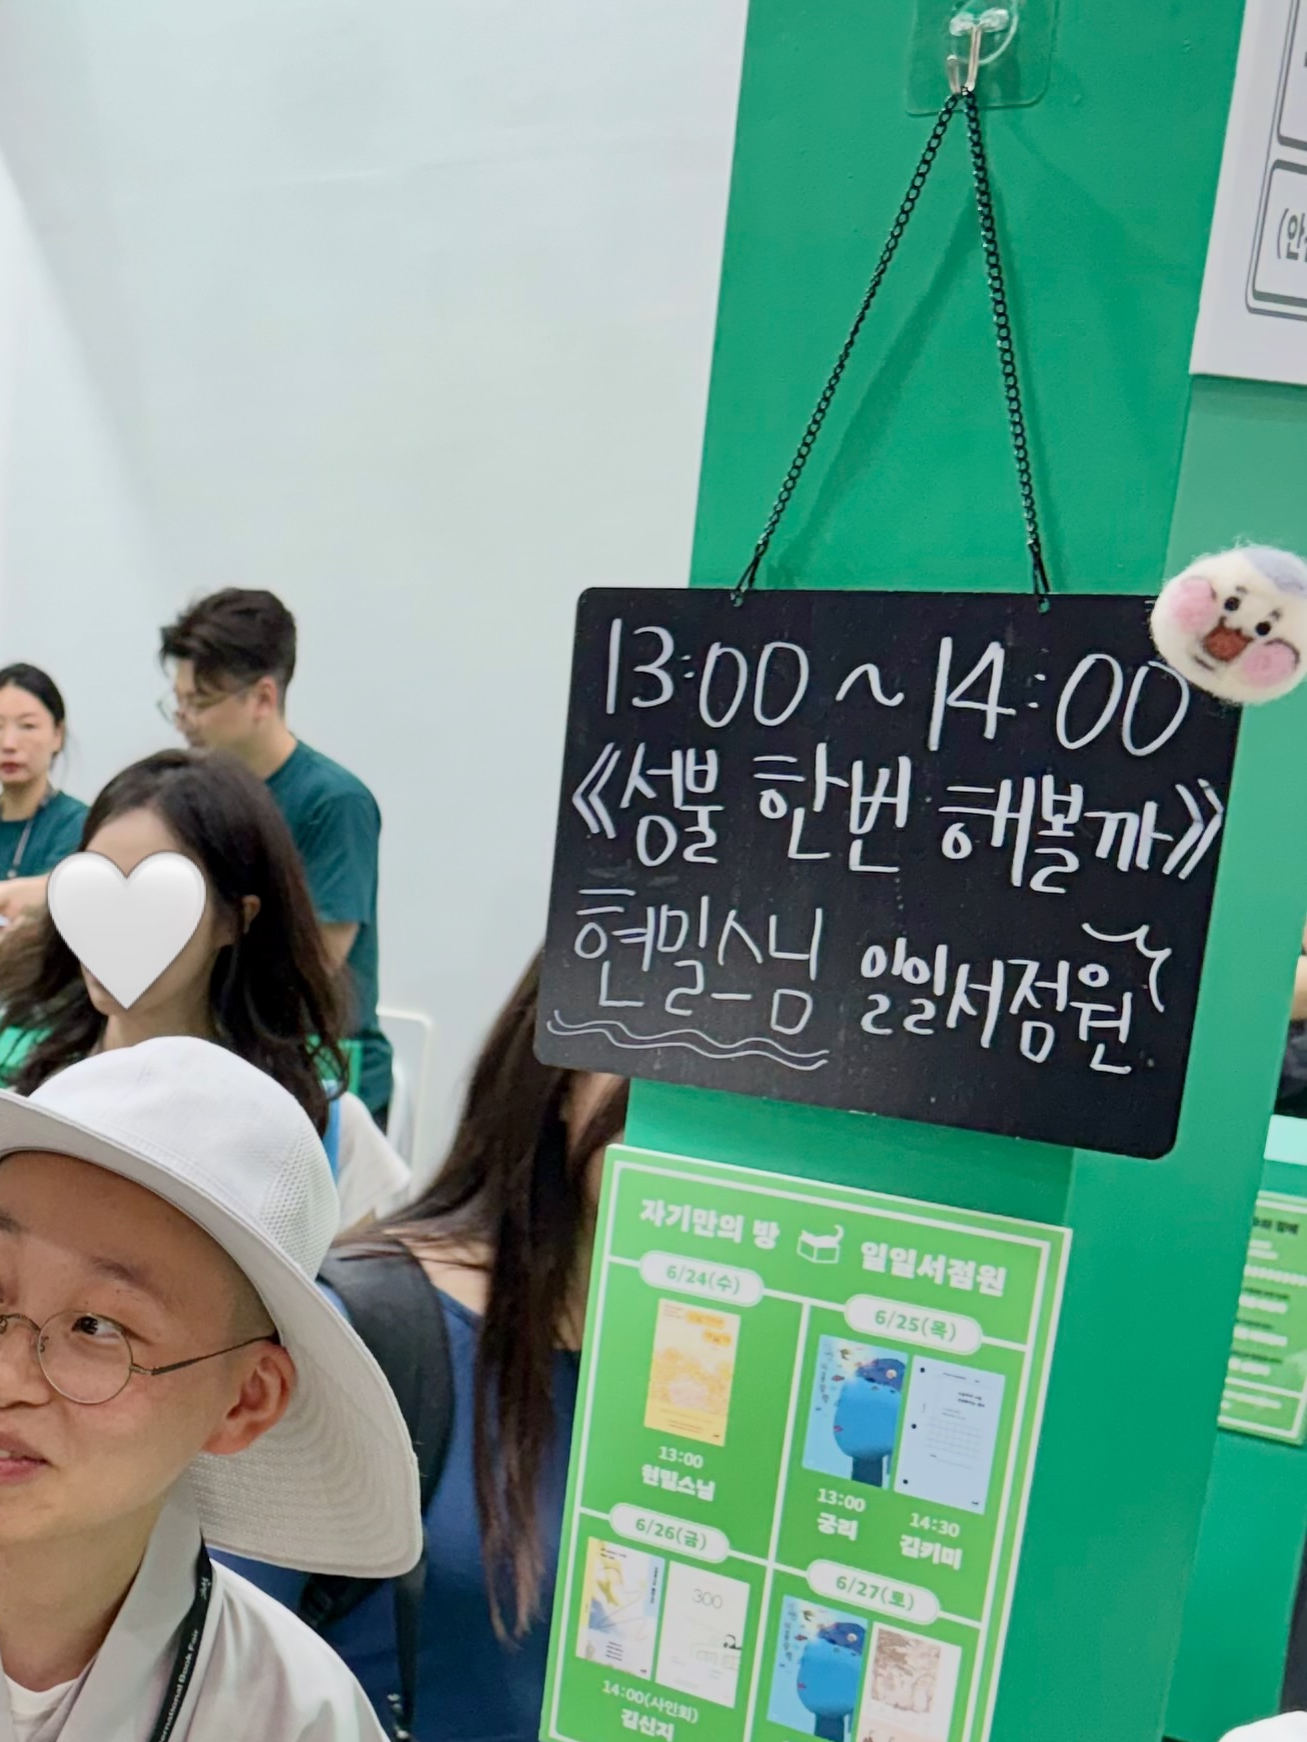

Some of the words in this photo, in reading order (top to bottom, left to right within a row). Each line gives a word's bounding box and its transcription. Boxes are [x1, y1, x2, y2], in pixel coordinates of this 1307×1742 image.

[605, 619, 810, 729] 13:00
[929, 637, 1189, 756] 14:00
[754, 743, 910, 873] 한번
[574, 889, 824, 1035] 현밀스님
[861, 937, 1132, 1074] 일일서점원
[639, 1199, 745, 1244] 자기만의
[752, 1220, 780, 1250] 방
[860, 1241, 1007, 1297] 일일서점원
[665, 1264, 741, 1296] 6/24(수)
[874, 1309, 957, 1343] 6/25(목)
[658, 1446, 705, 1469] 13:00
[816, 1488, 867, 1512] 13:00
[635, 1517, 707, 1552] 6/26(금)
[816, 1512, 859, 1541] 궁리
[909, 1512, 961, 1538] 14:30
[899, 1534, 962, 1571] 김키미
[836, 1575, 915, 1612] 6/27(토)
[178, 1652, 193, 1683] Book
[620, 1707, 675, 1742] 김신지
